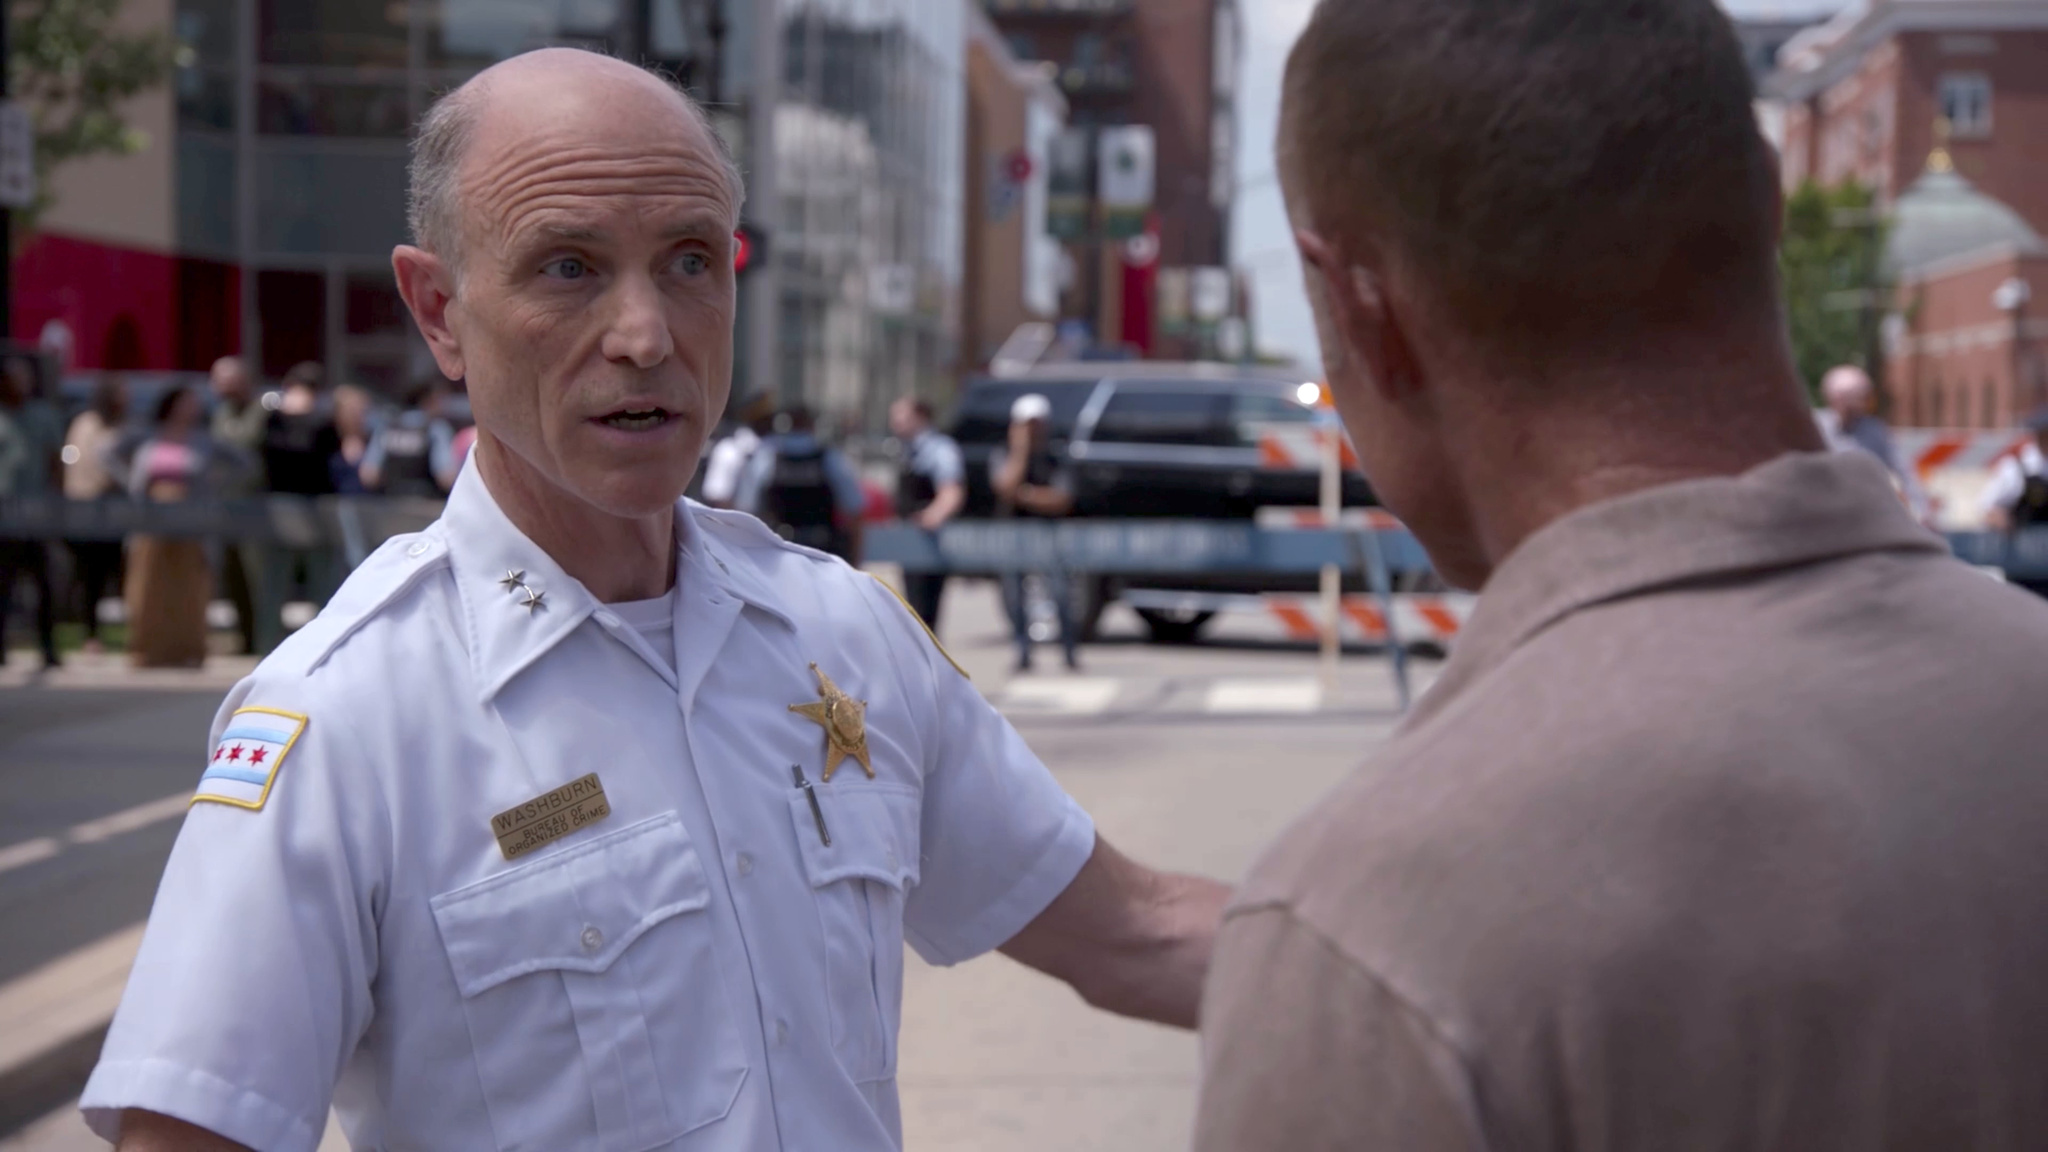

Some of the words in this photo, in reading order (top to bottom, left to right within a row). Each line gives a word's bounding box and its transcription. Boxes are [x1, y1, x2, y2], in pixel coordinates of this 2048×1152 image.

[497, 777, 597, 830] WASHBURN
[523, 813, 566, 839] BUREAU
[570, 804, 584, 817] OF
[508, 822, 569, 855] ORGANIZED
[572, 804, 606, 827] CRIME
